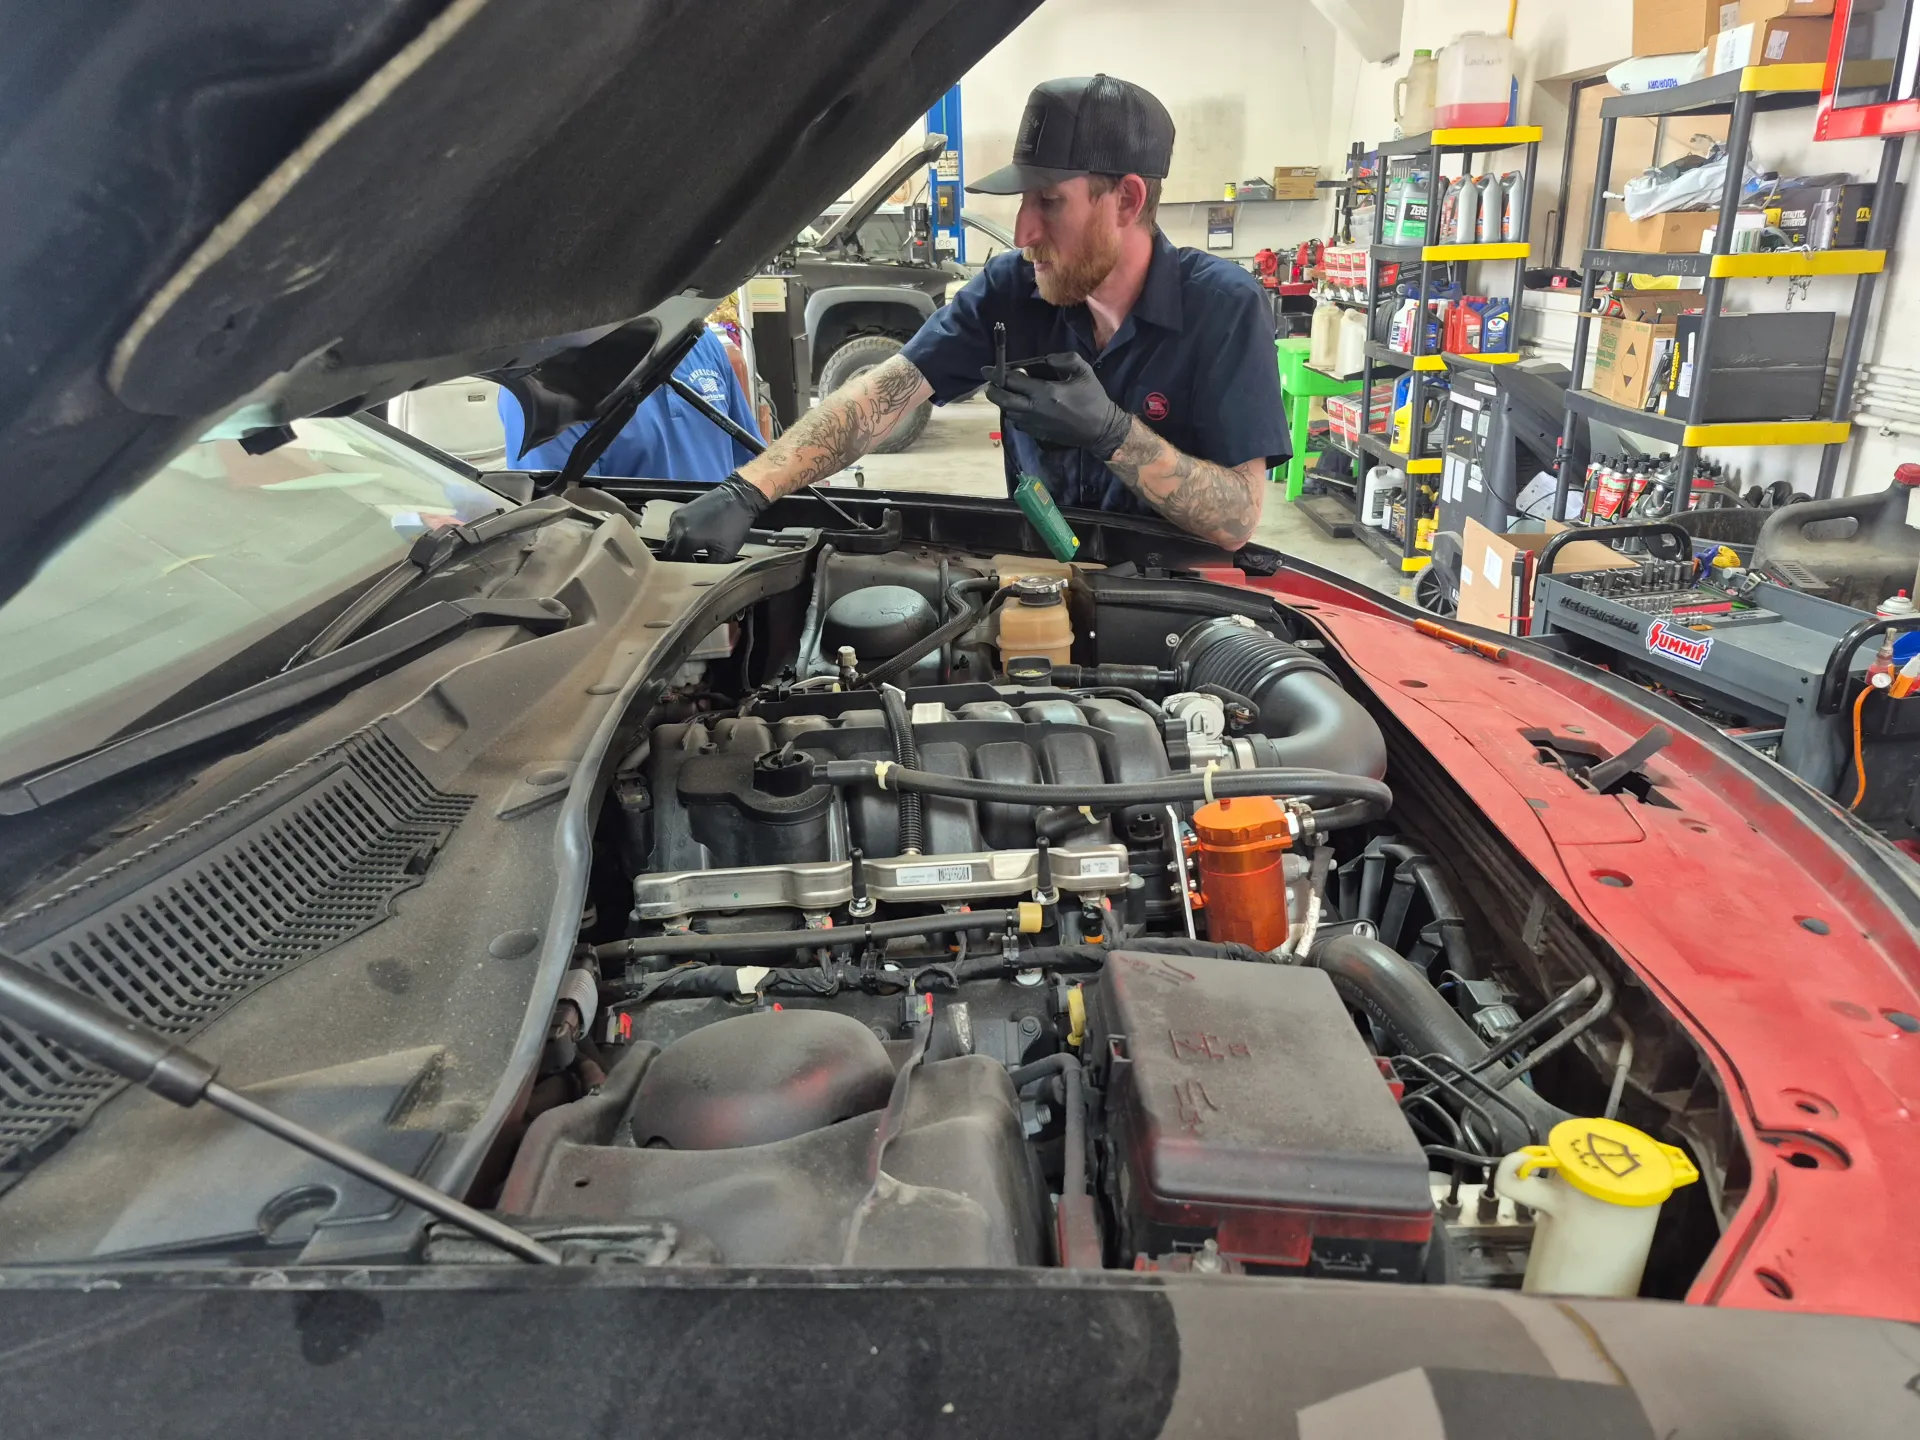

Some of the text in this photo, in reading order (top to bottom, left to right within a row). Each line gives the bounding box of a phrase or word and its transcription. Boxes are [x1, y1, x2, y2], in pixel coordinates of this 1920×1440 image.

[1410, 204, 1428, 216] ZERE
[1781, 209, 1806, 219] CATALYTIC
[1667, 259, 1688, 273] PARTS
